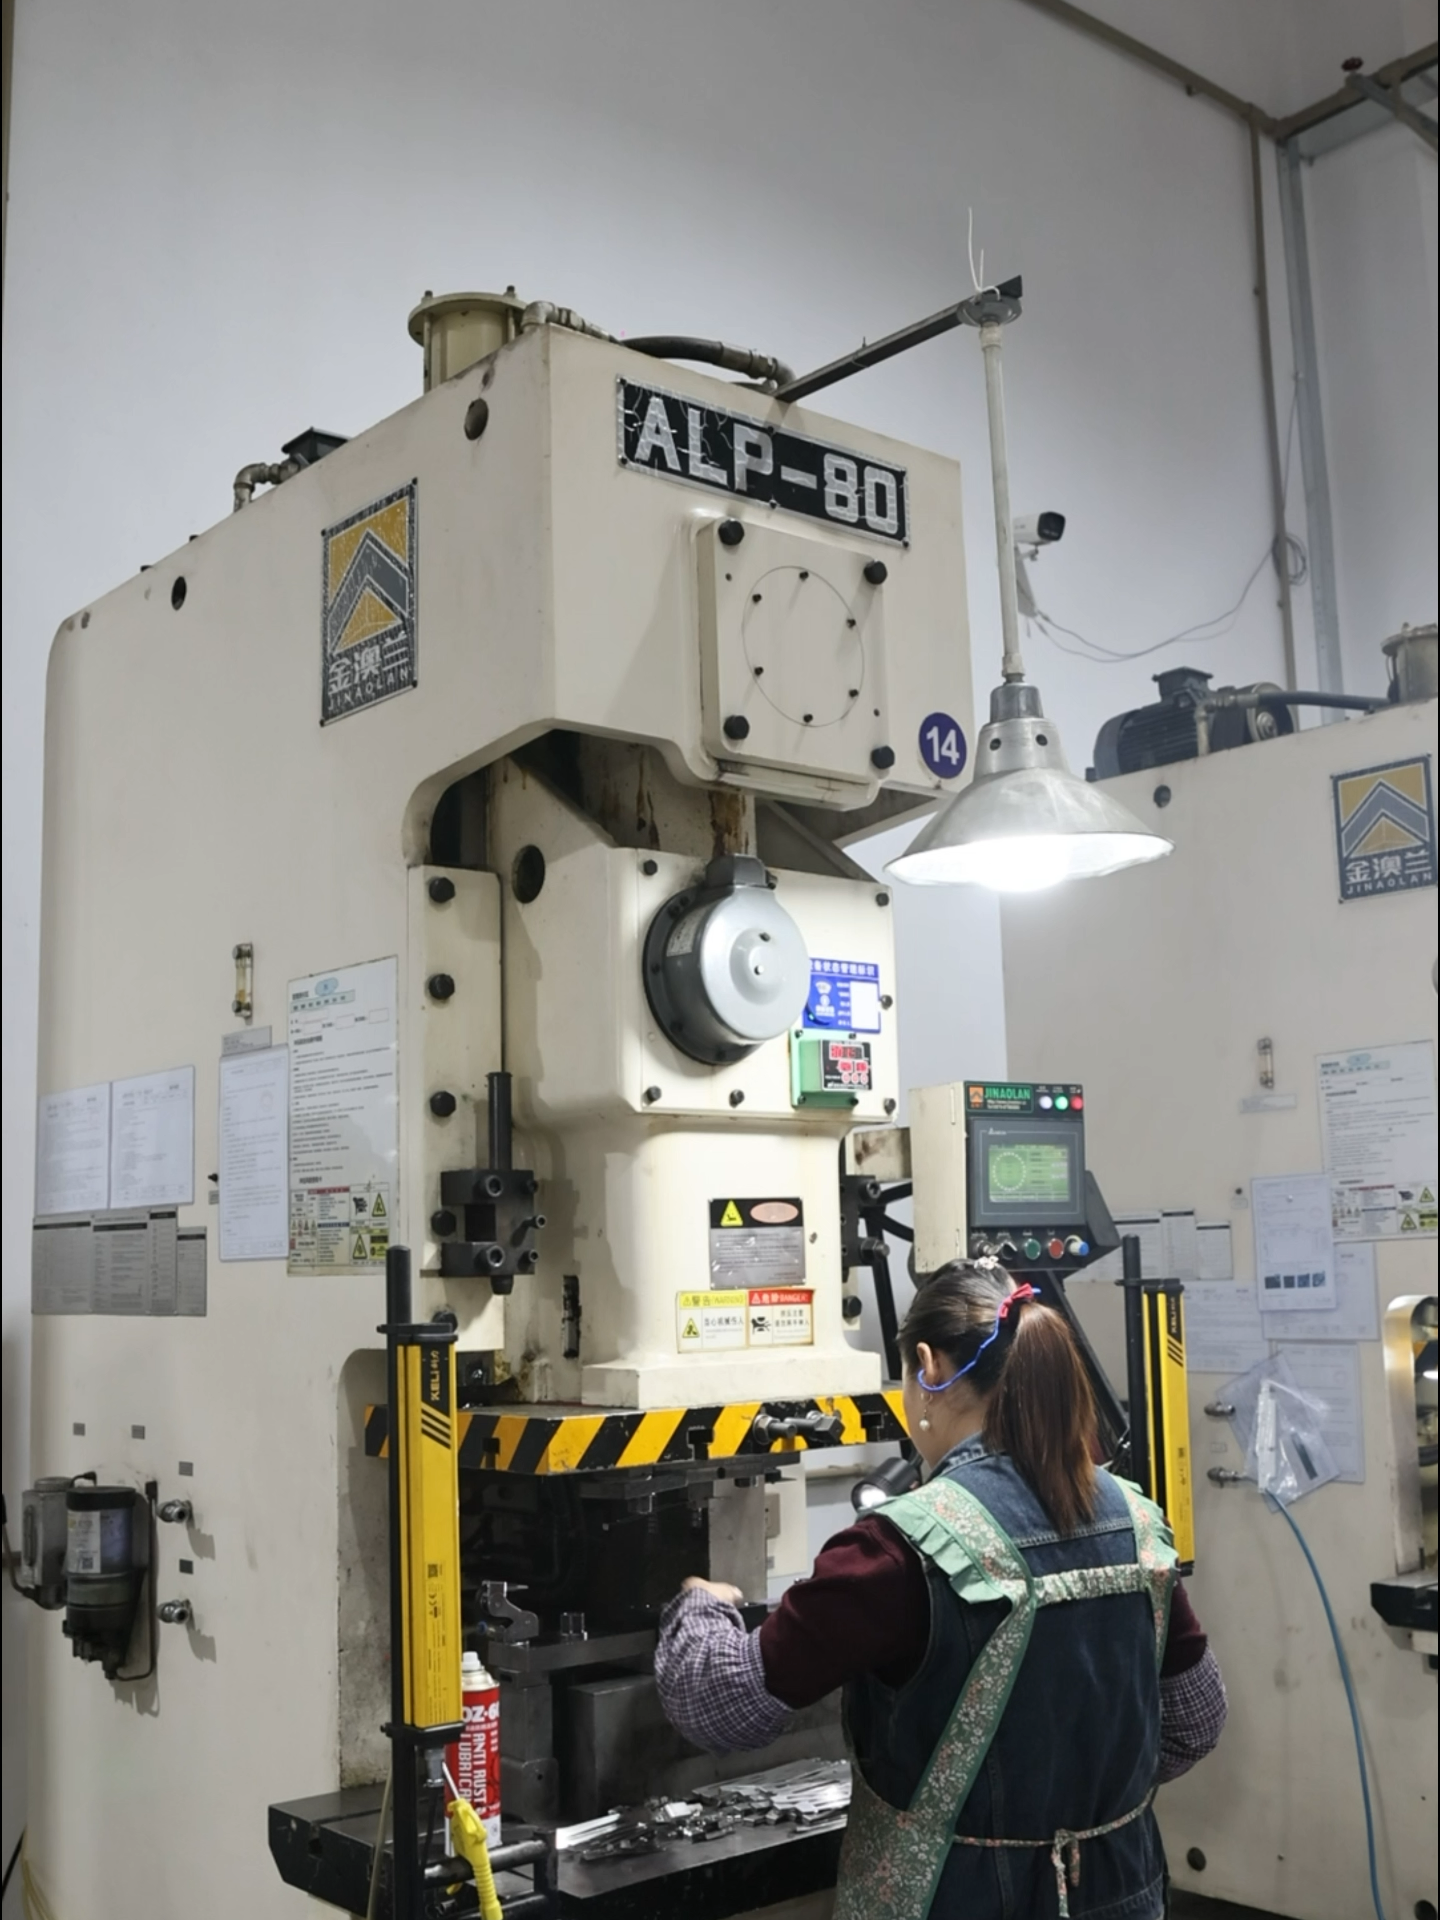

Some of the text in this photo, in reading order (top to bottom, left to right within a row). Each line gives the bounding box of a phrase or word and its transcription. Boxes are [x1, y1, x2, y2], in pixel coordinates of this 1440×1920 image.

[634, 394, 899, 535] ALP-80
[328, 630, 409, 695] 金澳兰
[328, 665, 409, 711] JINAOLAN
[926, 725, 960, 766] 14
[1345, 848, 1432, 885] 金澳兰
[1346, 871, 1432, 895] JINAOLAN
[985, 1087, 1031, 1100] JINAOLAN
[458, 1733, 472, 1803] LUBRICA
[473, 1732, 487, 1765] ANTI
[473, 1770, 487, 1804] RUST
